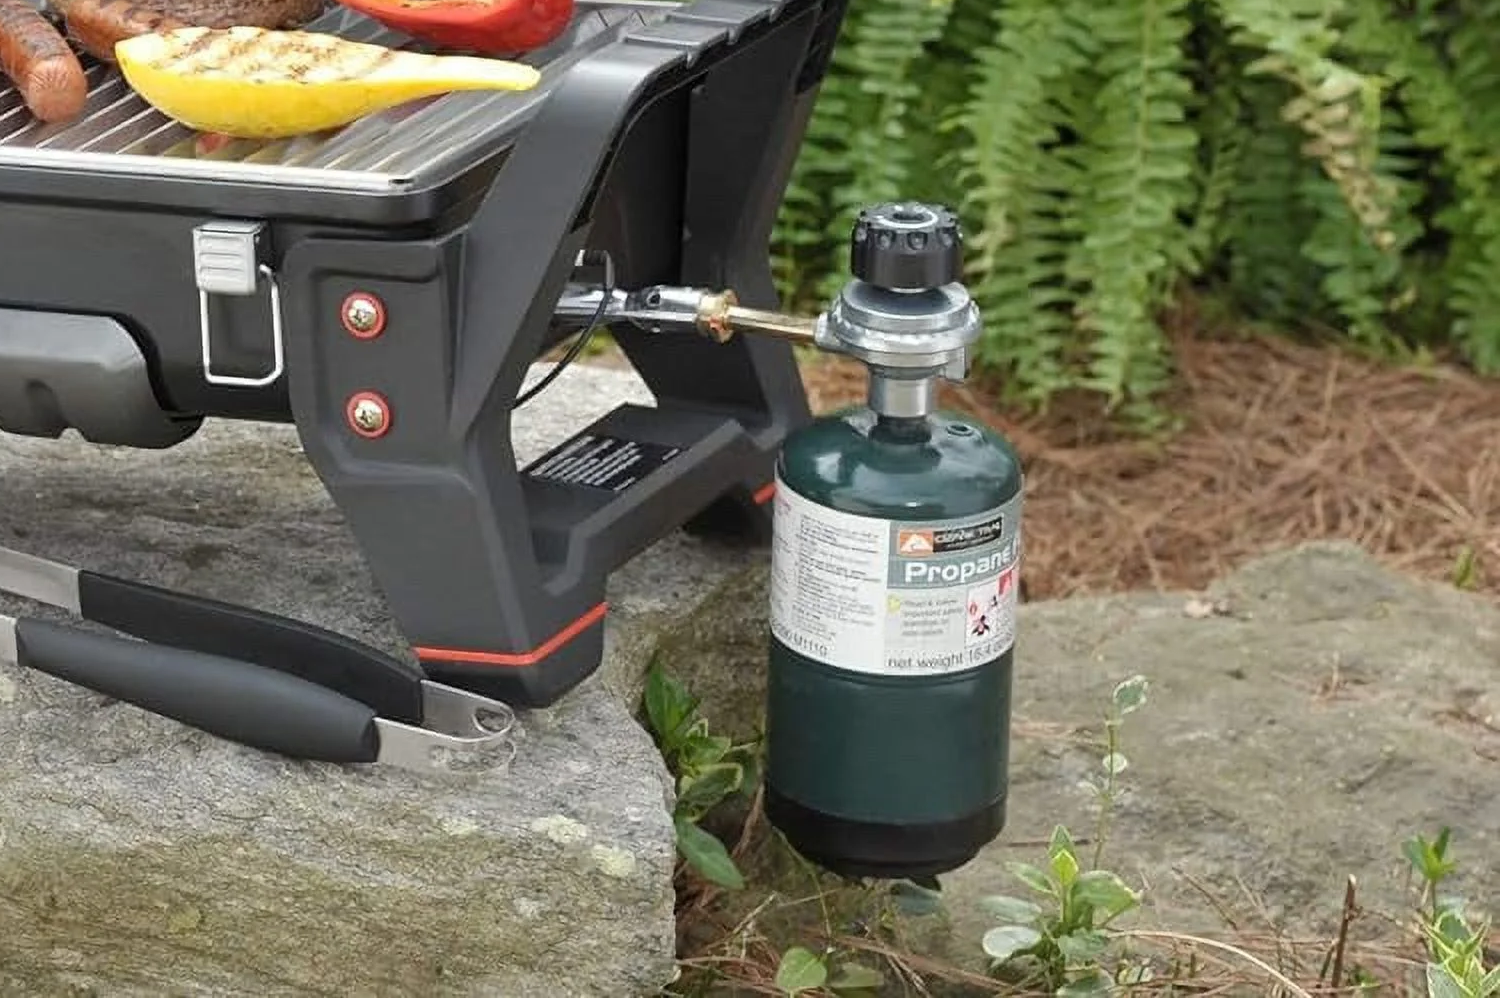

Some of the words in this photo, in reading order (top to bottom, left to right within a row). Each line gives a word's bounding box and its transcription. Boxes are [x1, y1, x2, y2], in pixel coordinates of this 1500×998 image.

[905, 544, 1011, 583] Propane
[888, 656, 912, 667] net
[916, 651, 964, 670] weight
